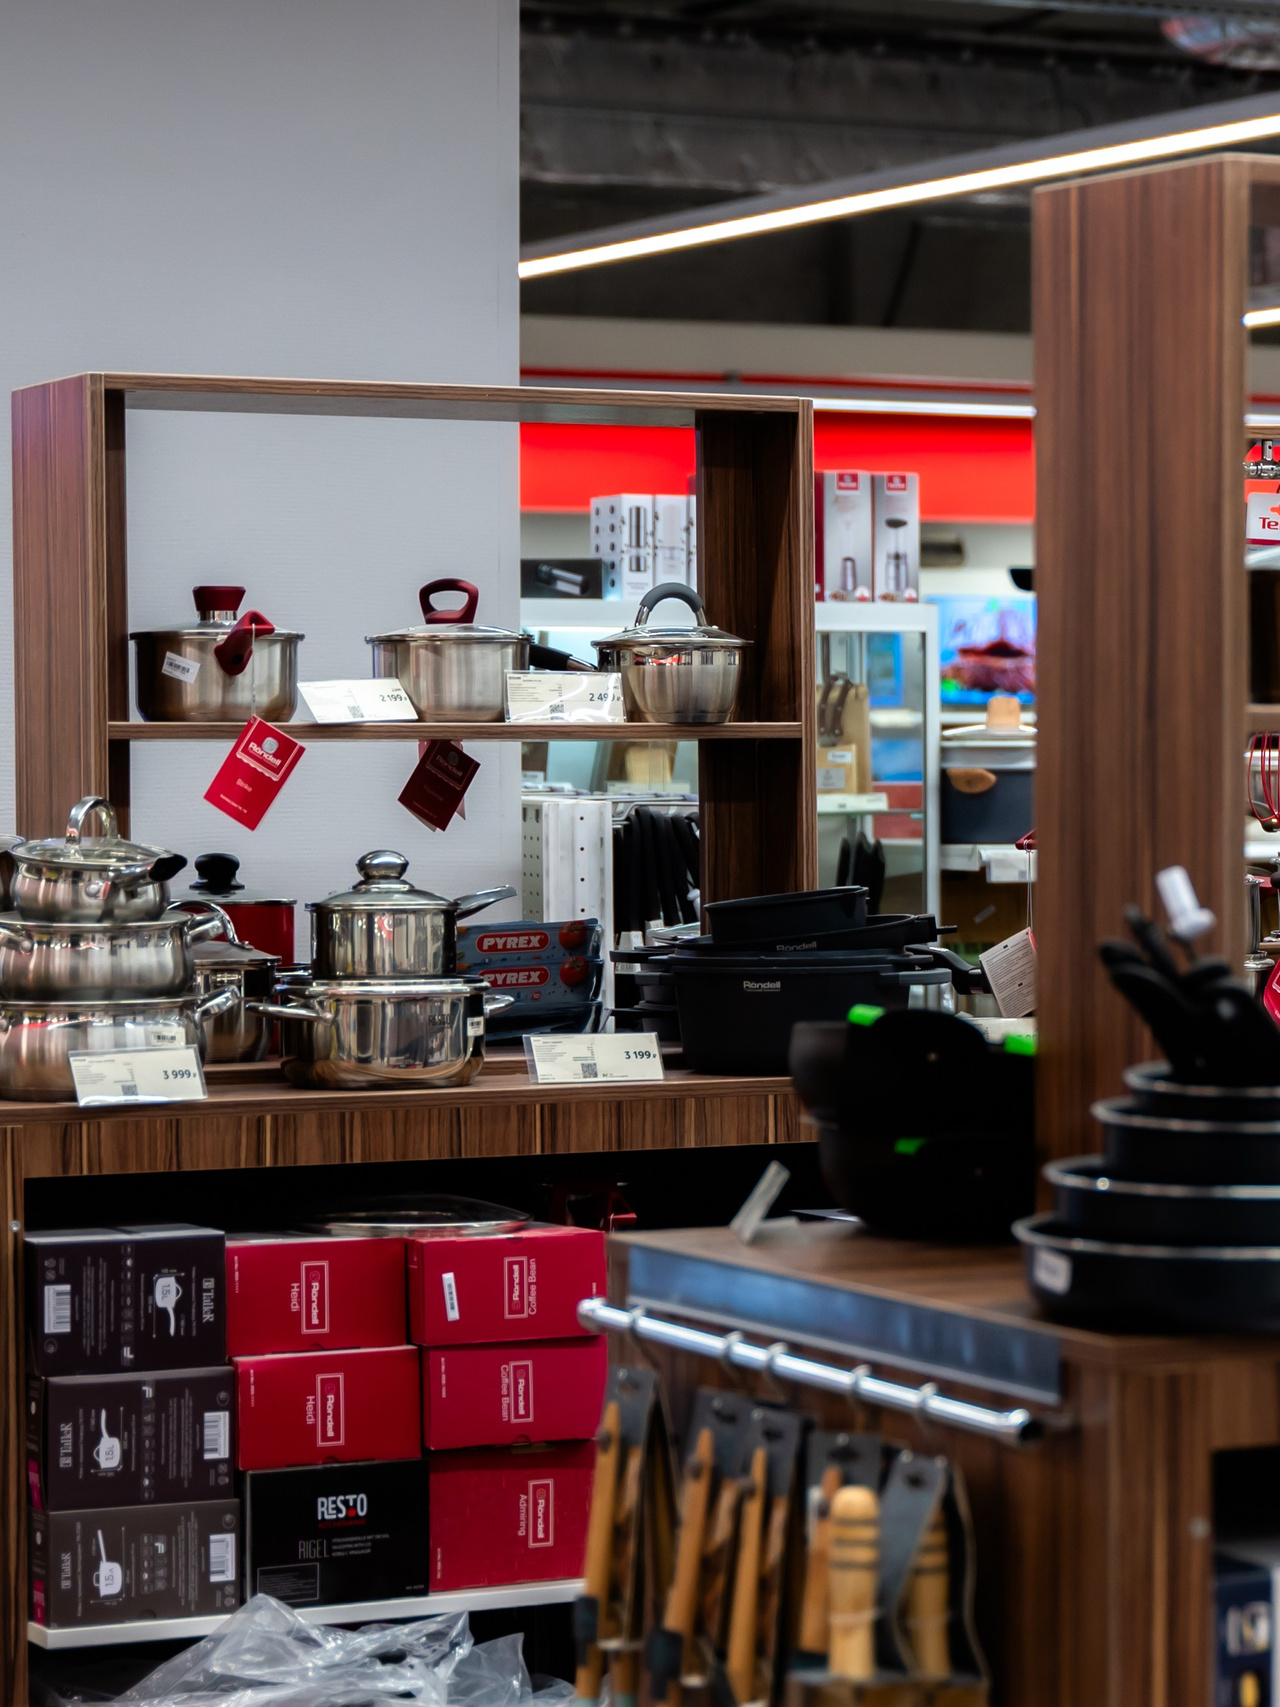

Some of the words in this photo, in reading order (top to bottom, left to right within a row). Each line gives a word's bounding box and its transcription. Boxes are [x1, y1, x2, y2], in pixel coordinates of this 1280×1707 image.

[388, 693, 403, 702] 199
[482, 935, 542, 950] PYREX
[483, 970, 541, 985] PYREX
[624, 1051, 631, 1060] 3
[634, 1050, 651, 1059] 199
[162, 1070, 170, 1080] 3
[171, 1069, 192, 1079] 999
[290, 1282, 300, 1312] Heidi
[528, 1285, 537, 1315] Coffee
[500, 1364, 509, 1395] Coffee
[306, 1395, 315, 1425] Heidi
[317, 1493, 368, 1521] RESTO
[517, 1494, 528, 1536] Admiring
[298, 1538, 331, 1561] RIGEL
